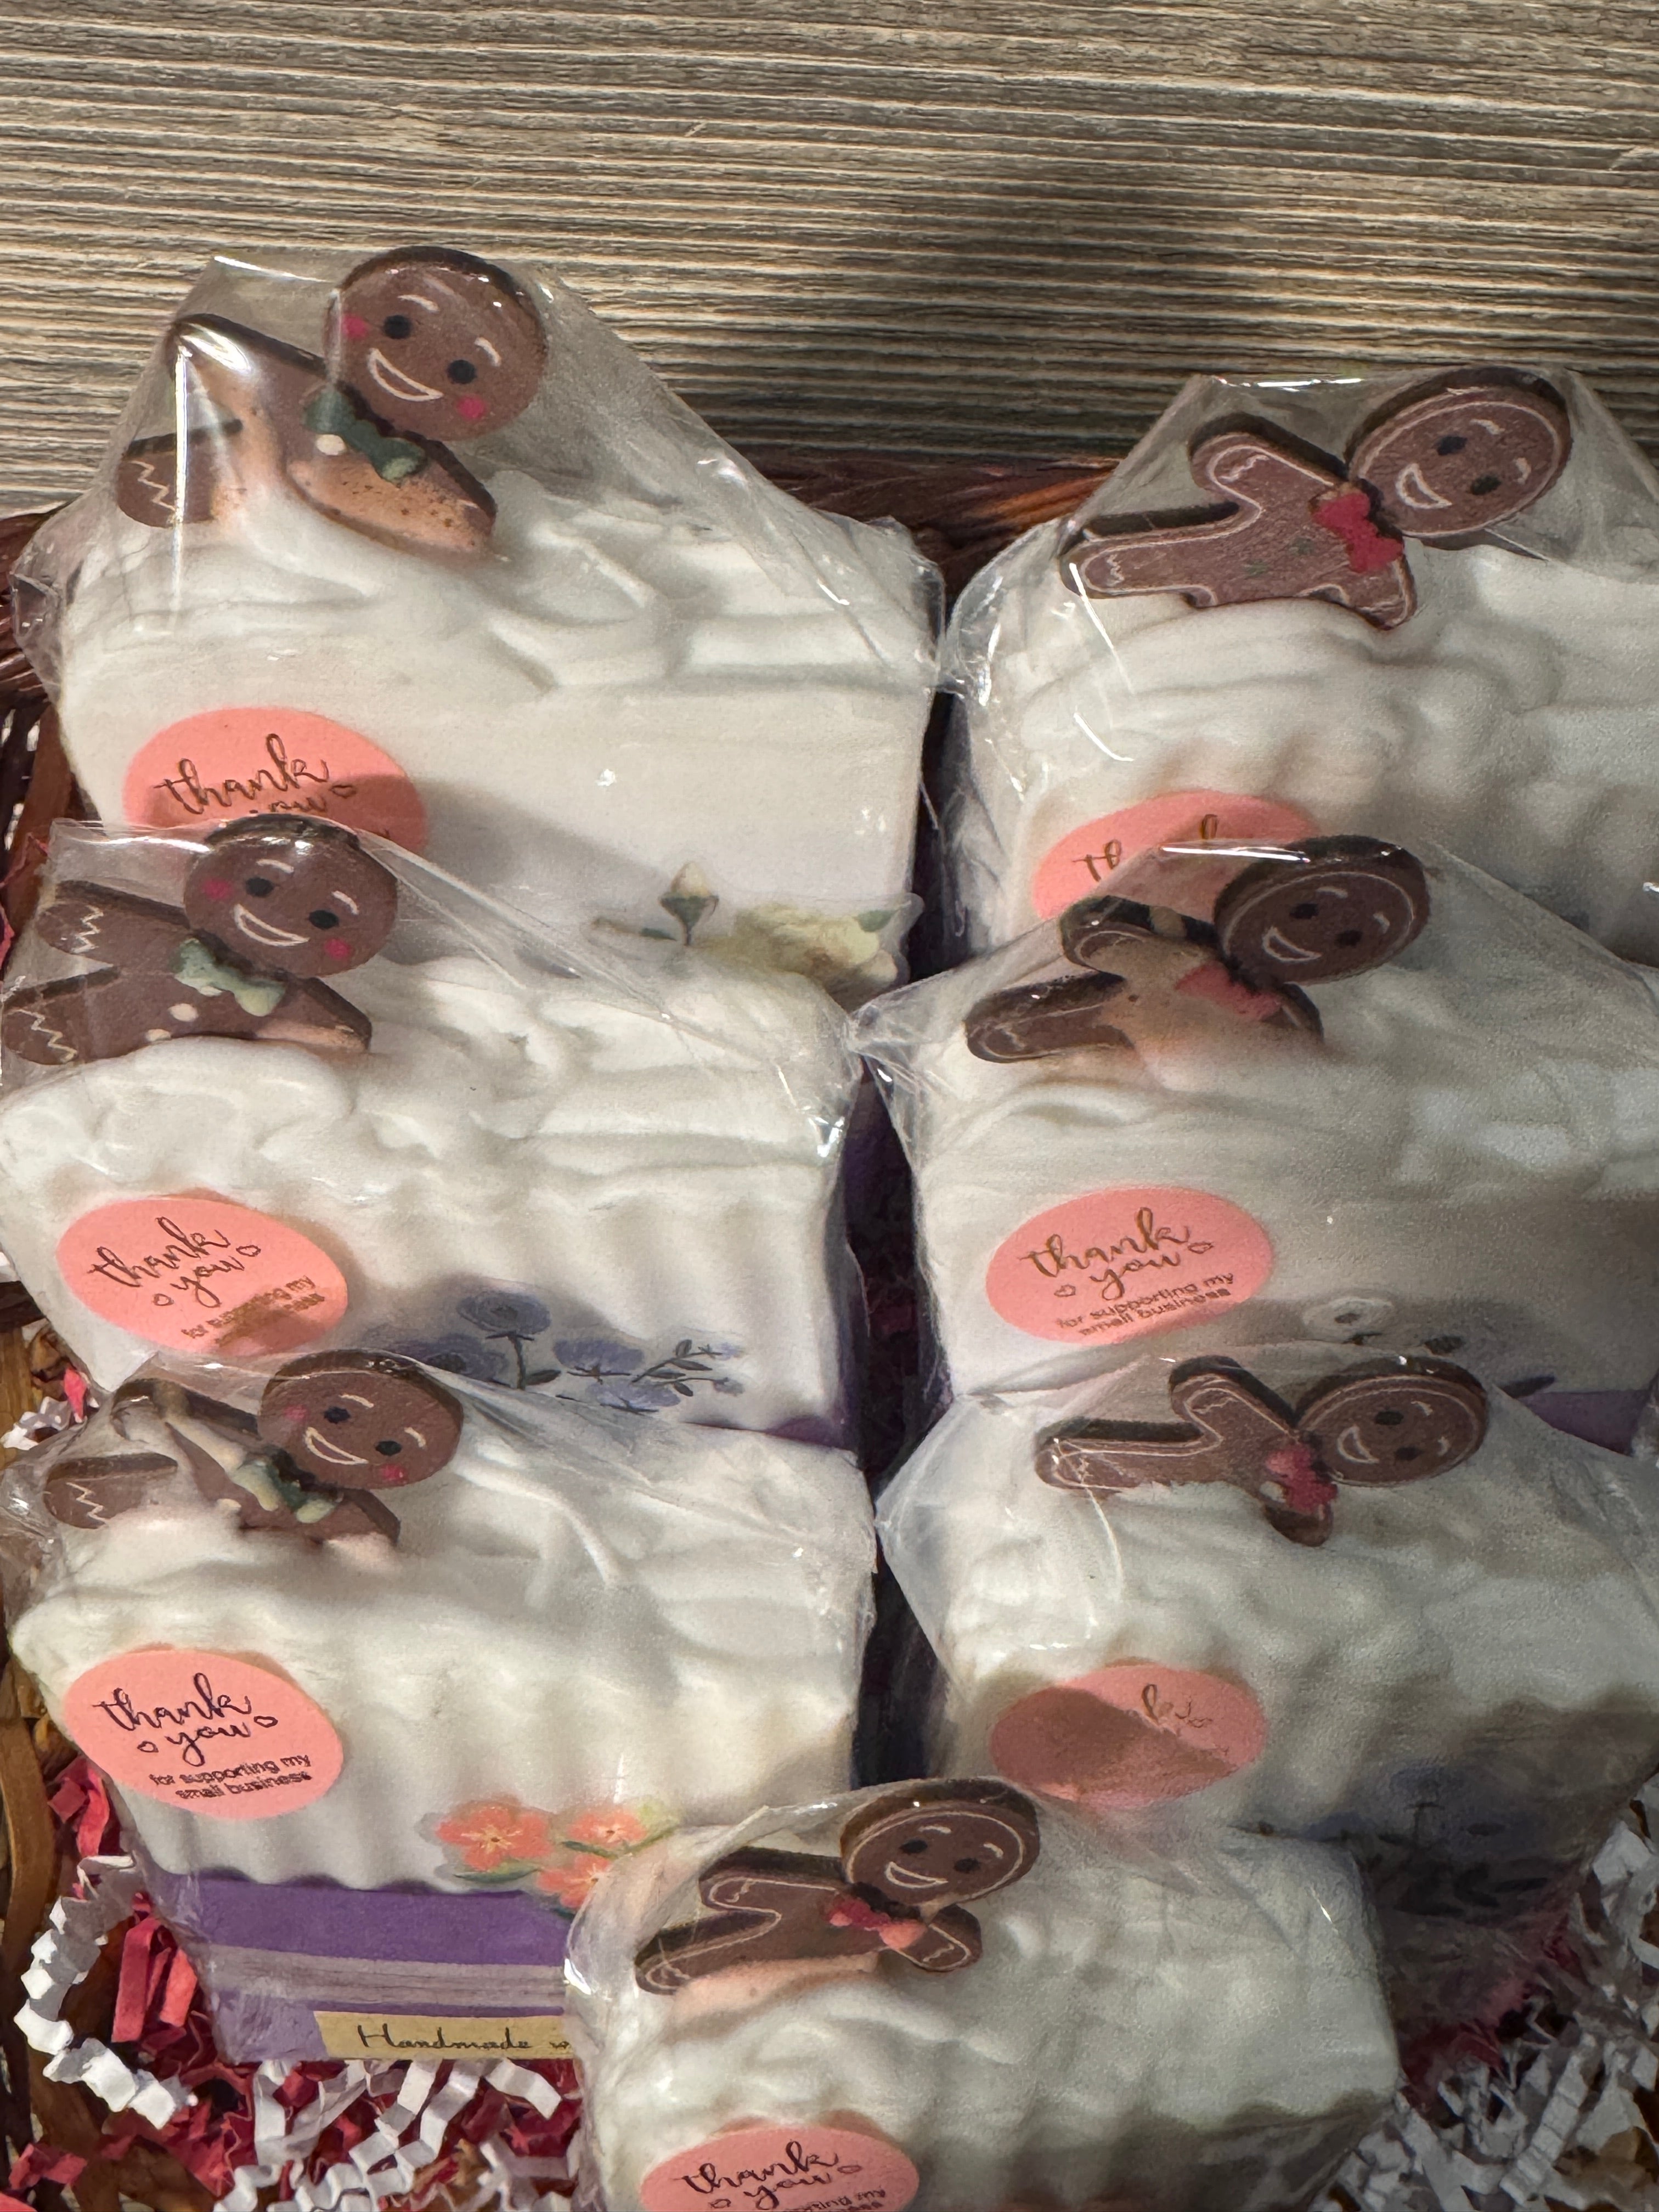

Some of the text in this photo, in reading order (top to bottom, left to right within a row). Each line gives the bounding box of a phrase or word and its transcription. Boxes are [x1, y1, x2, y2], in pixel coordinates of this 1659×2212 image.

[154, 733, 330, 815] thank
[87, 1216, 231, 1288] thank
[1019, 1206, 1191, 1278] thank
[170, 1255, 245, 1308] you
[1089, 1252, 1182, 1301] you
[92, 1672, 252, 1731] thank
[164, 1722, 251, 1767] you
[179, 1760, 280, 1785] supporting
[280, 1754, 311, 1767] my
[357, 2023, 532, 2050] Handmade
[674, 2140, 839, 2194] thank
[743, 2172, 832, 2210] you
